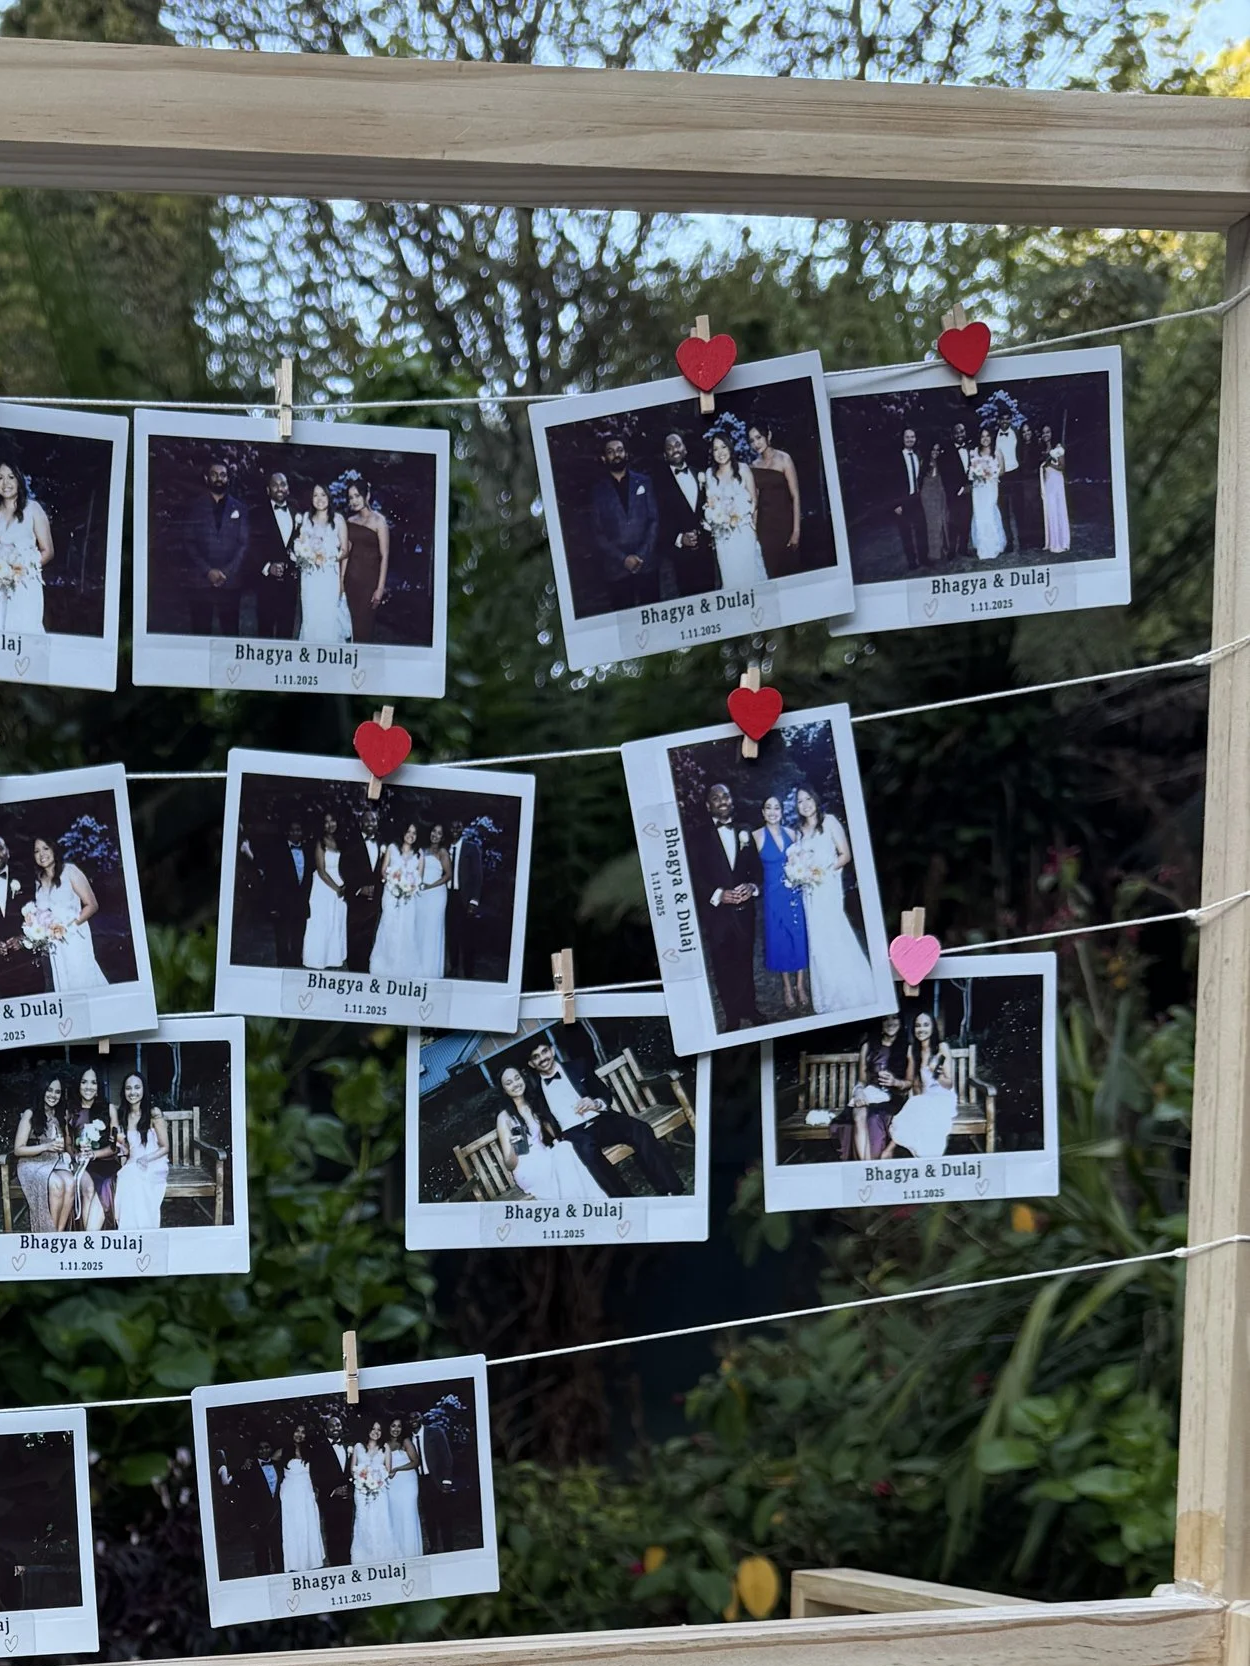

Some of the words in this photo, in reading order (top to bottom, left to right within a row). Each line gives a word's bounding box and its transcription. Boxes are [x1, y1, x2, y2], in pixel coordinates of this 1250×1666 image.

[932, 575, 987, 596] Bhagya
[993, 573, 1004, 588] &
[1010, 568, 1051, 588] Dulaj
[640, 605, 695, 626] Bhagya
[700, 600, 711, 614] &
[716, 589, 755, 610] Dulaj
[970, 599, 1013, 612] 1.11.2025
[680, 624, 722, 640] 1.11.2025
[235, 644, 295, 666] Bhagya
[299, 648, 311, 663] &
[316, 648, 358, 668] Dulaj
[275, 674, 318, 686] 1.11.2025
[664, 828, 683, 886] Bhagya
[650, 872, 666, 917] 1.11.2025
[674, 893, 688, 905] &
[676, 909, 696, 953] Dulaj
[308, 973, 364, 994] Bhagya
[370, 980, 382, 994] &
[386, 980, 428, 1001] Dulaj
[2, 1005, 15, 1020] &
[20, 998, 64, 1018] Dulaj
[344, 1004, 387, 1016] 1.11.2025
[866, 1167, 919, 1186] Bhagya
[924, 1164, 936, 1179] &
[941, 1161, 982, 1180] Dulaj
[903, 1188, 945, 1200] 1.11.2025
[504, 1204, 560, 1223] Bhagya
[566, 1204, 578, 1218] &
[582, 1202, 623, 1221] Dulaj
[20, 1234, 77, 1254] Bhagya
[83, 1235, 95, 1250] &
[101, 1234, 143, 1254] Dulaj
[542, 1229, 585, 1240] 1.11.2025
[60, 1261, 104, 1271] 1.11.2025
[292, 1574, 346, 1591] Bhagya
[351, 1570, 362, 1583] &
[367, 1564, 406, 1582] Dulaj
[330, 1592, 372, 1606] 1.11.2025
